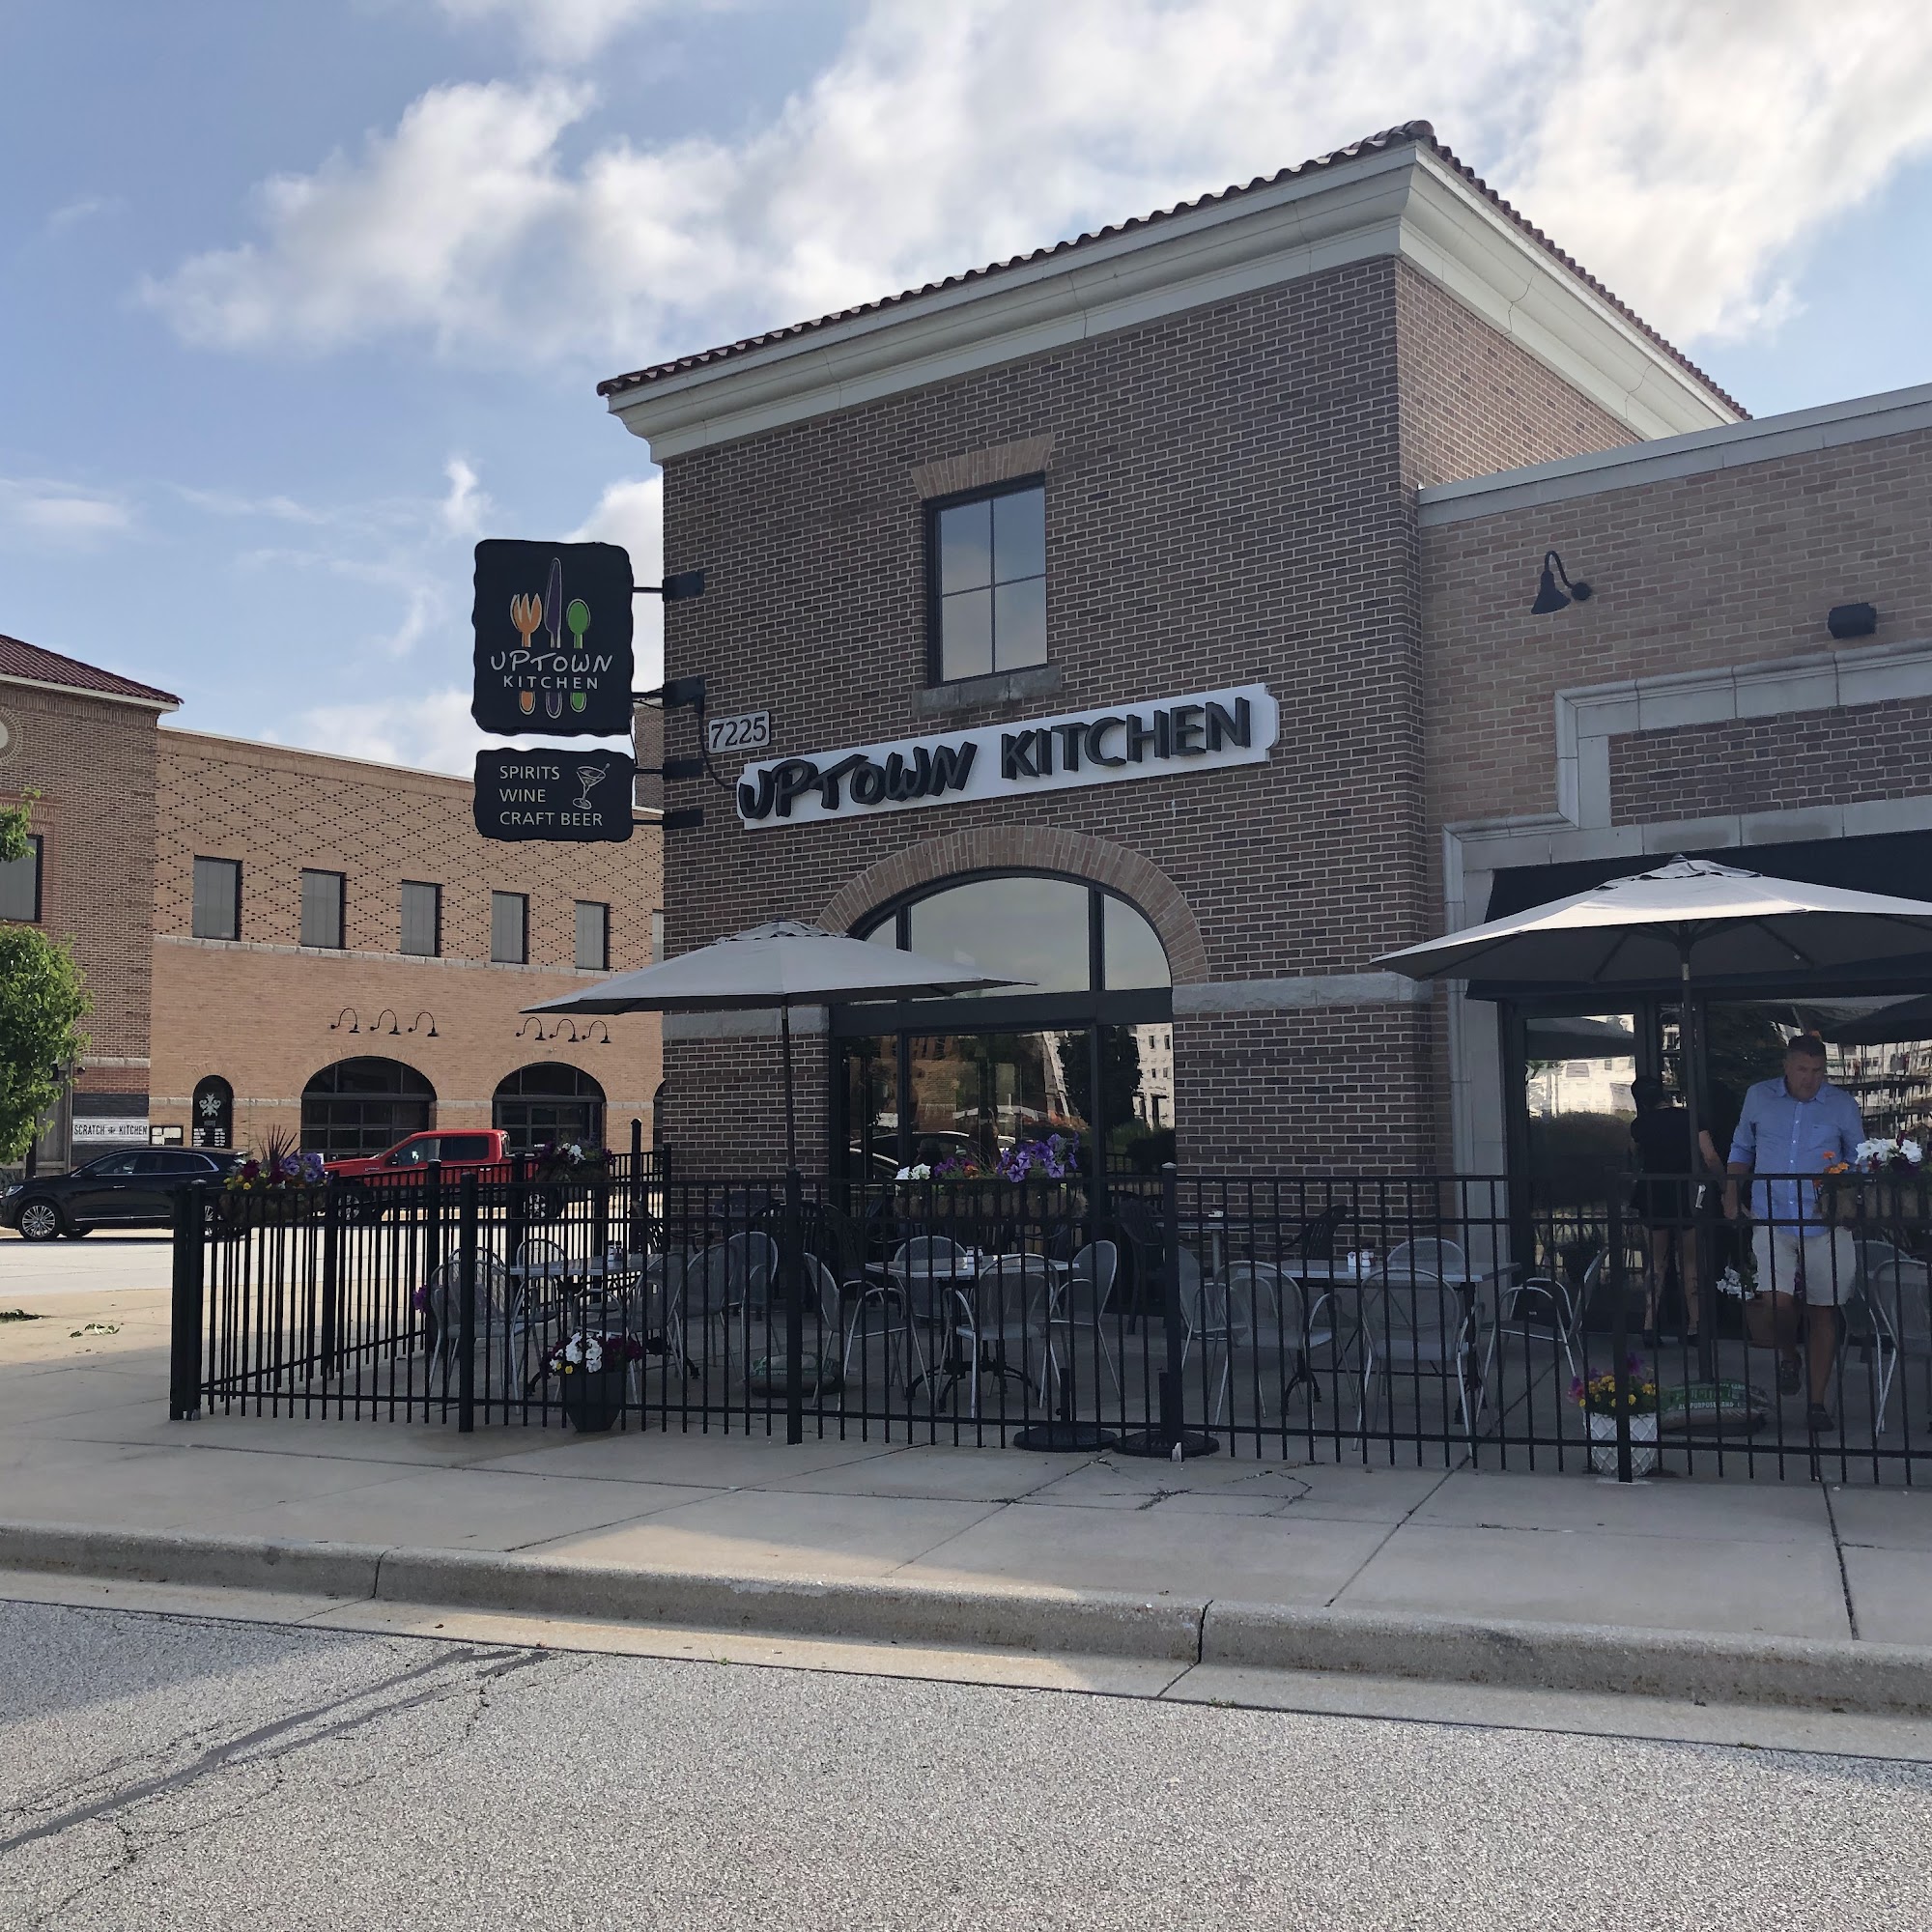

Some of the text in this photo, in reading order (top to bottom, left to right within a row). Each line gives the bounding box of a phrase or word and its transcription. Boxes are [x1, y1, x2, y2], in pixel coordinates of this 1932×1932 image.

[491, 649, 613, 673] UPTOWN
[503, 675, 598, 690] KITCHEN
[711, 716, 767, 749] 7225
[738, 696, 1251, 820] UPTOWN KITCHEN
[499, 765, 560, 781] SPIRITS
[498, 788, 547, 803] WINE
[499, 811, 604, 827] CRAFT BEER
[73, 1124, 148, 1135] SCRATCH KITCHEN
